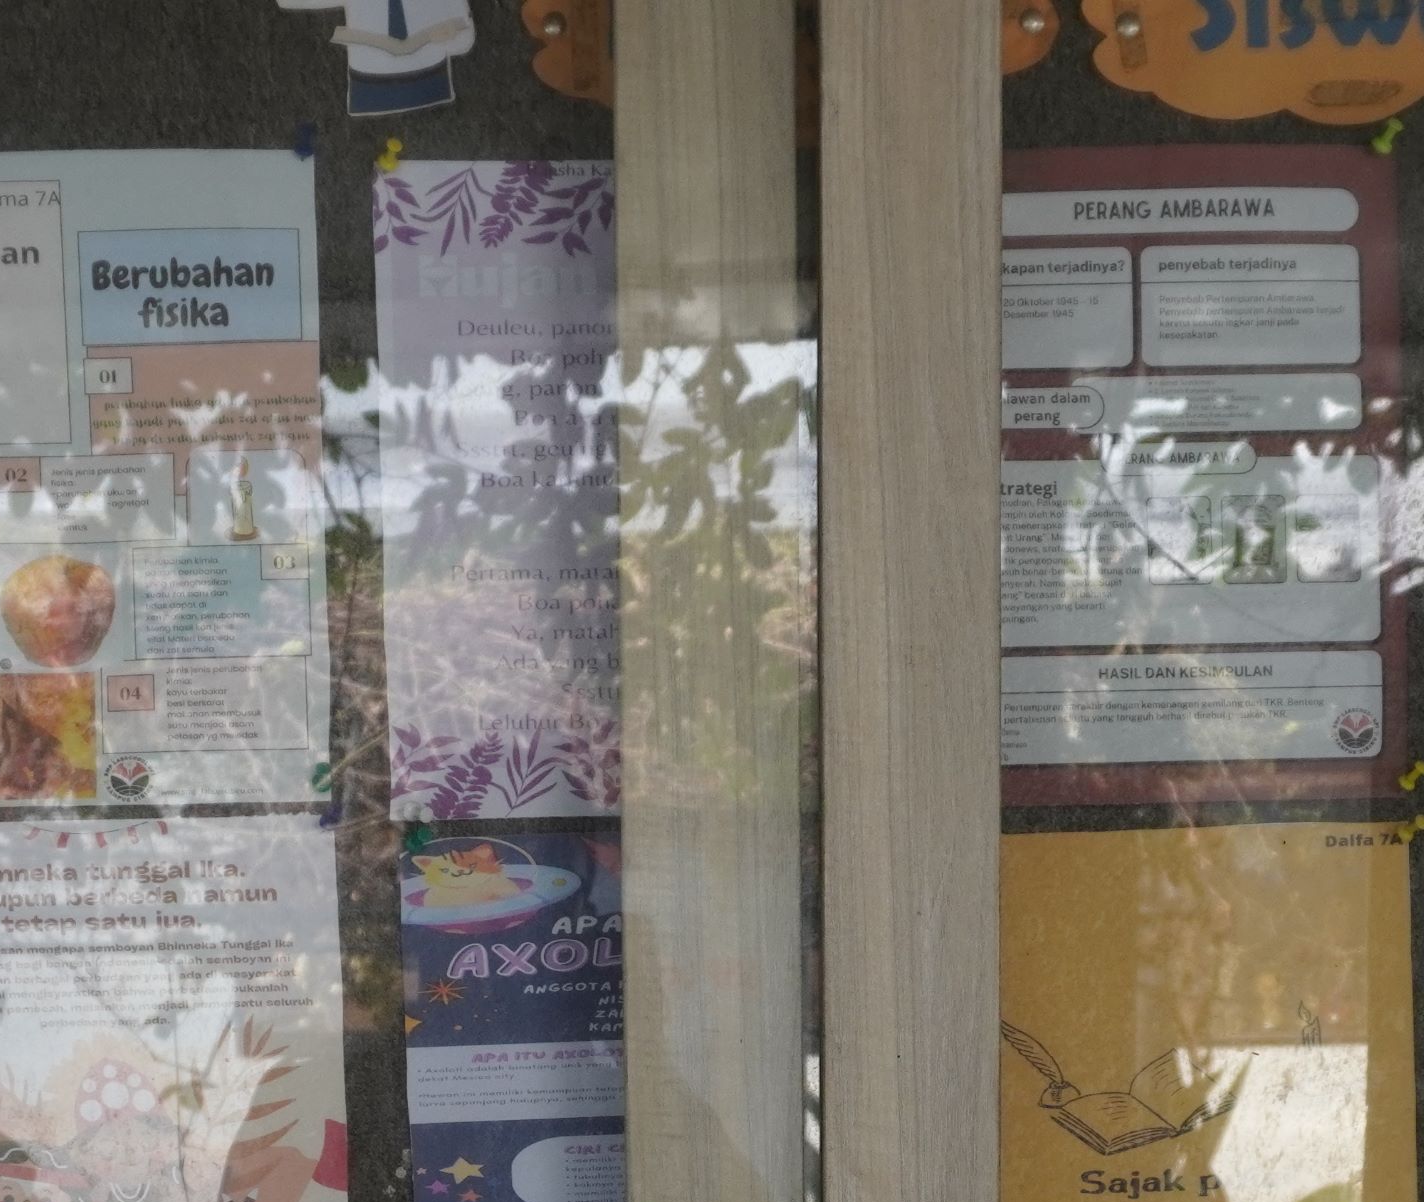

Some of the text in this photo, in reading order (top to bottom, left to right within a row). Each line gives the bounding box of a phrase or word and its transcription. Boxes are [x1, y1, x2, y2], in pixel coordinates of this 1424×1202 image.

[35, 191, 62, 207] 7A
[1073, 198, 1276, 222] PERANG AMBARAWA
[1002, 261, 1045, 276] kapan
[1228, 257, 1297, 273] terjadinya
[90, 256, 275, 291] Berubahan
[138, 296, 231, 330] fisika
[456, 319, 543, 339] Deuleu,
[99, 369, 118, 385] 01
[1013, 409, 1061, 426] perang
[4, 467, 28, 483] 02
[480, 472, 524, 488] Boa
[272, 555, 297, 570] 03
[450, 565, 552, 583] Pertama,
[517, 595, 562, 612] Boa
[511, 625, 540, 641] Ya,
[494, 655, 536, 671] Ada
[1097, 664, 1273, 681] HASIL DAN KESIMPULAN
[119, 686, 142, 702] 04
[479, 714, 560, 731] Leluhur
[1324, 833, 1403, 849] Dalfa 7A
[85, 861, 191, 884] tunggal
[1, 912, 146, 935] tetap satu
[523, 981, 612, 995] ANGGOTA
[1079, 1169, 1186, 1200] Sajak
